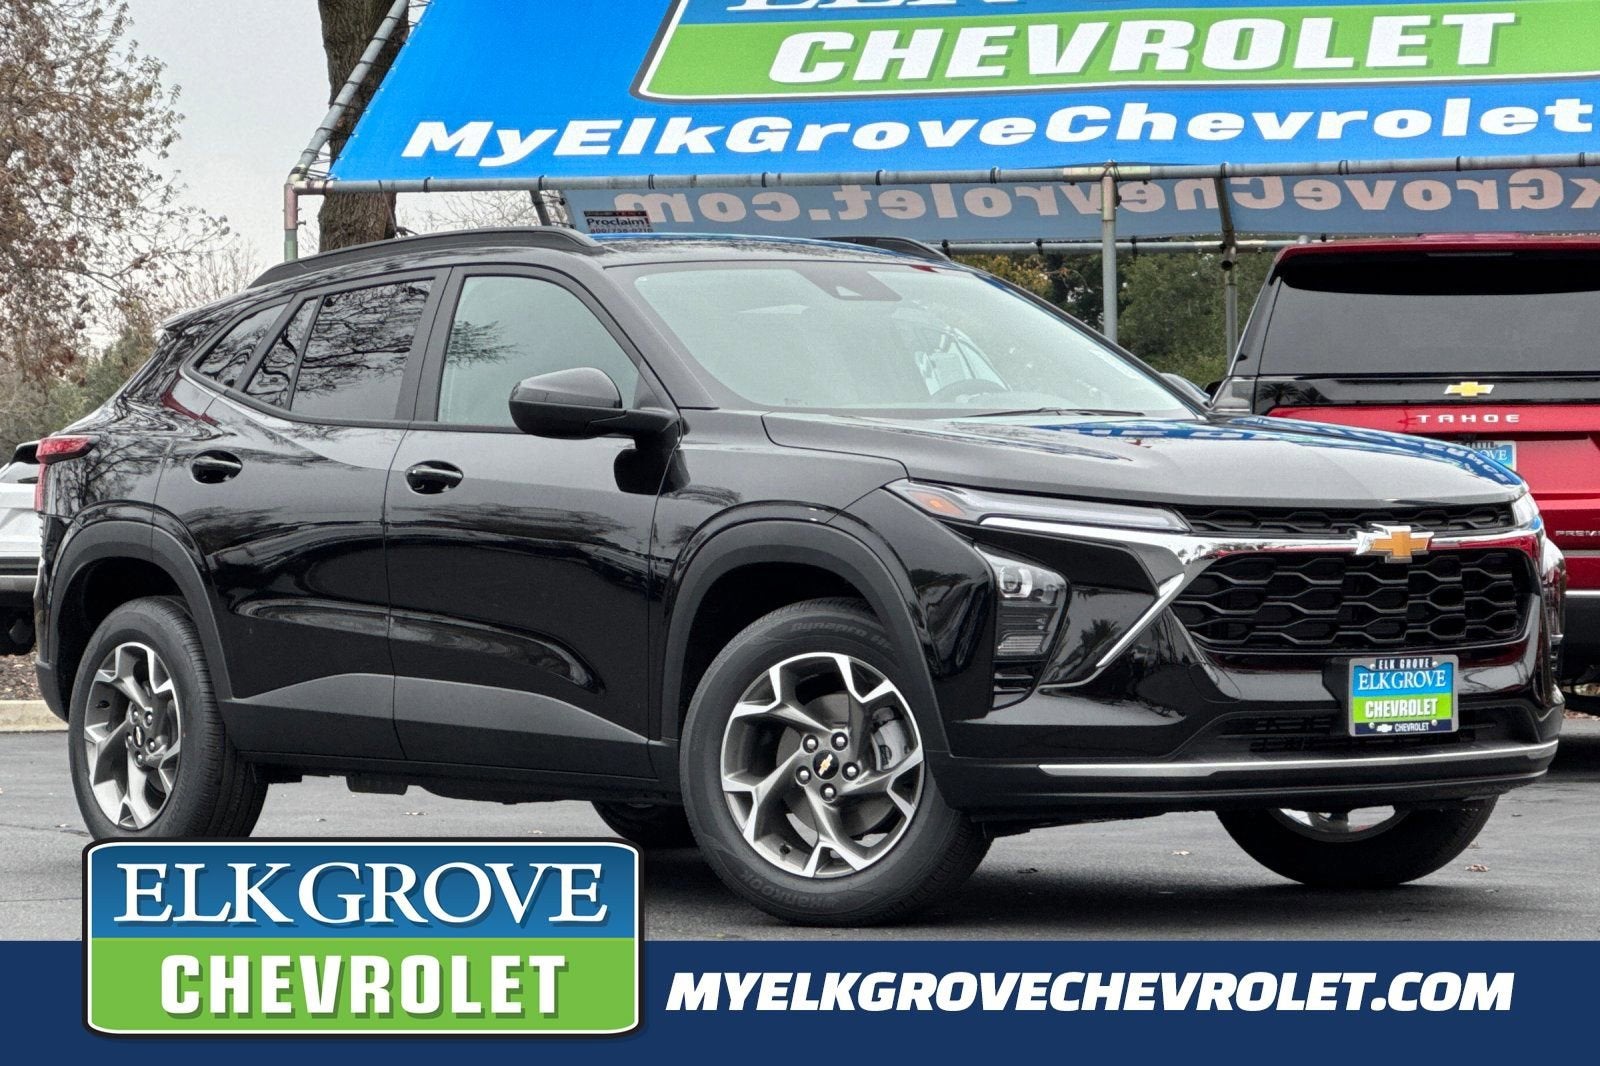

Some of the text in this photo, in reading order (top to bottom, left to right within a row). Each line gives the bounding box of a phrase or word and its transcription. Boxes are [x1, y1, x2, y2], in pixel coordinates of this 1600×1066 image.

[767, 12, 1516, 84] CHEVROLET
[401, 98, 1594, 168] MyElkGroveChevrolet
[1416, 413, 1521, 424] TAHOE
[1378, 658, 1430, 670] ELK GROVE
[1358, 670, 1446, 690] ELK GROVE
[1365, 698, 1438, 718] CHEVROLET
[1394, 723, 1429, 732] CHEVROLET
